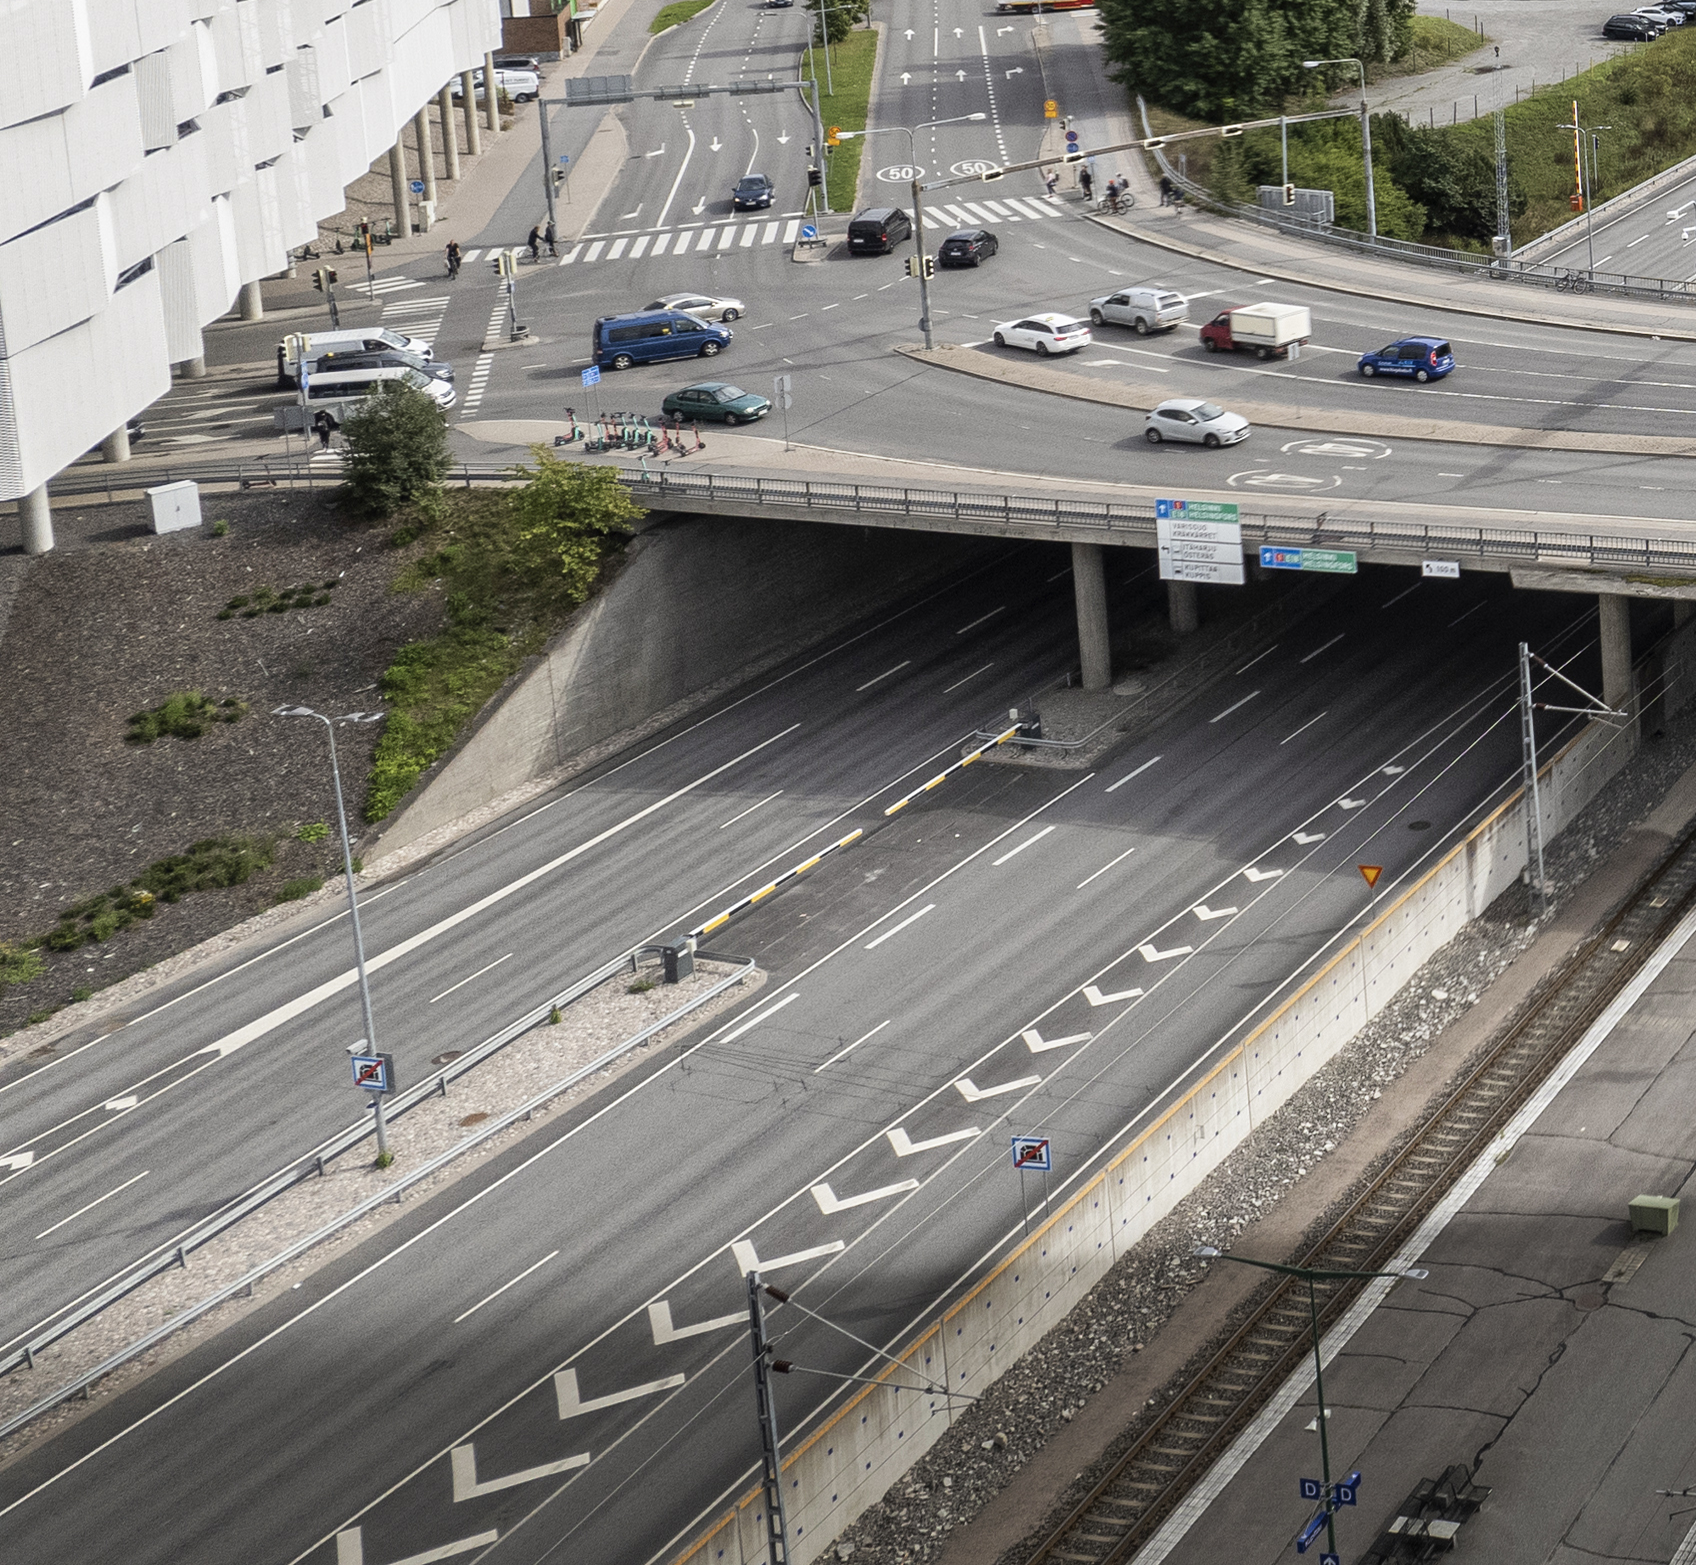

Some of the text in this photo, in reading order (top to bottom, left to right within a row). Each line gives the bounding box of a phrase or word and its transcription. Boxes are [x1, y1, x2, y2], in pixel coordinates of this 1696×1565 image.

[889, 167, 914, 180] 50
[962, 162, 987, 175] 50
[1305, 1482, 1316, 1496] D
[1341, 1488, 1352, 1501] D
